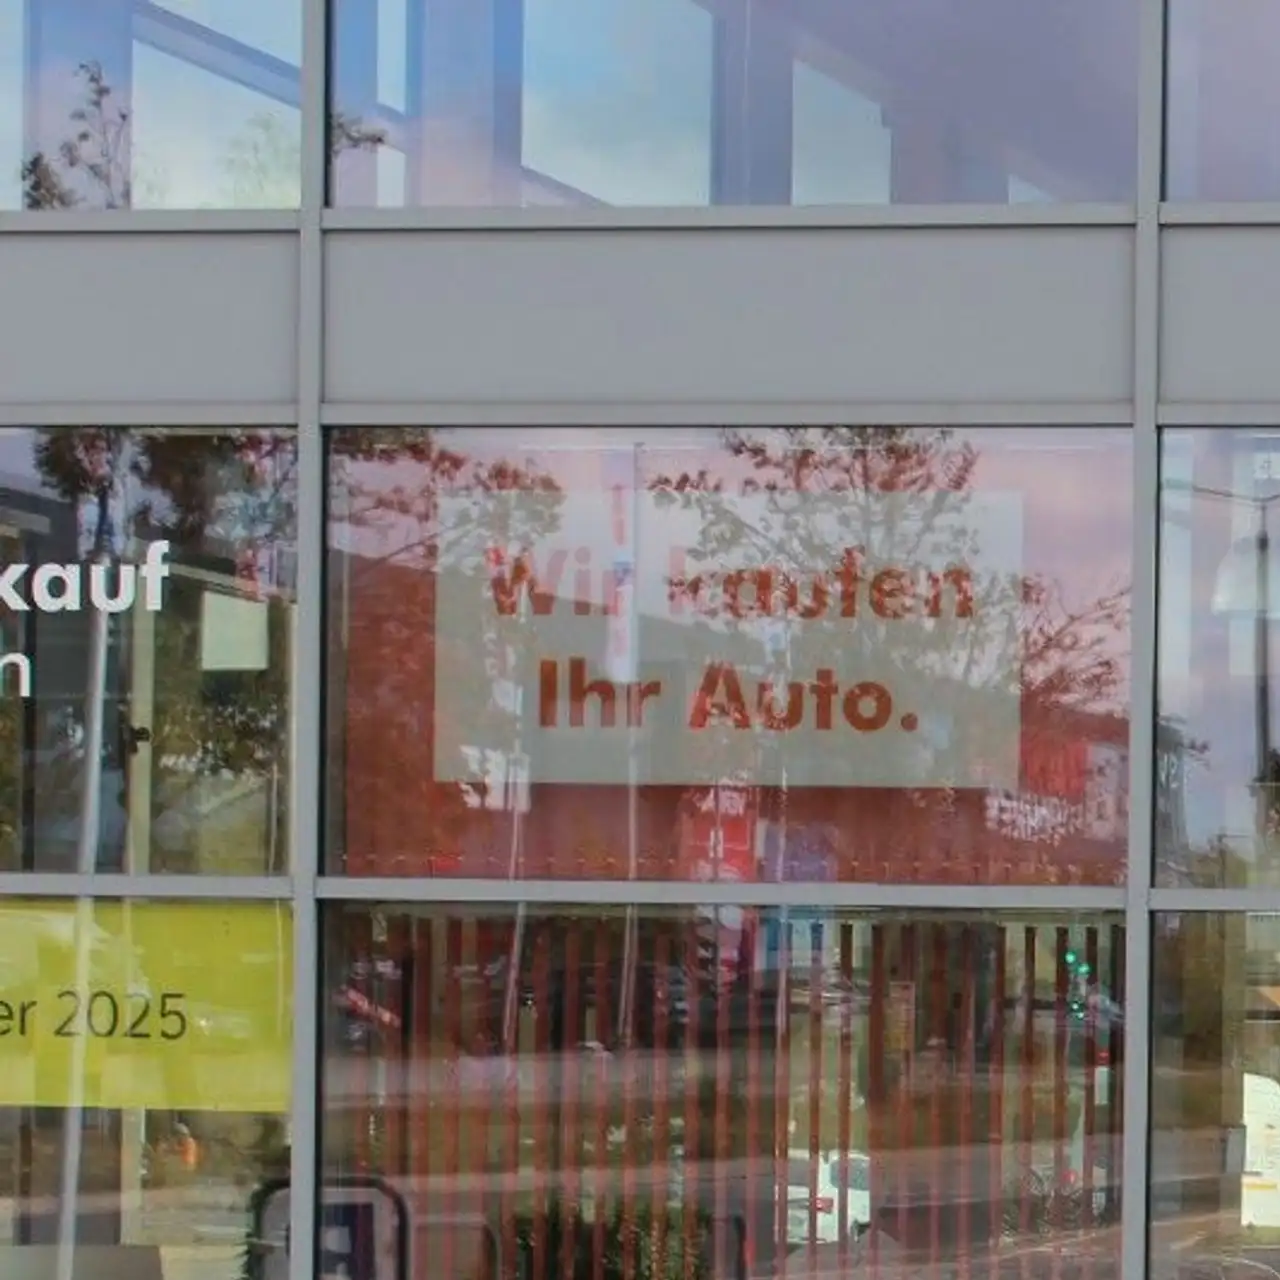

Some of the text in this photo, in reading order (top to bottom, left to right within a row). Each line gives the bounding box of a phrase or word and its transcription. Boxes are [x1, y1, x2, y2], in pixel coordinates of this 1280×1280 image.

[0, 540, 170, 612] kauf
[667, 544, 976, 618] kaufen
[539, 658, 918, 731] Ihr Auto.
[54, 991, 186, 1040] 2025
